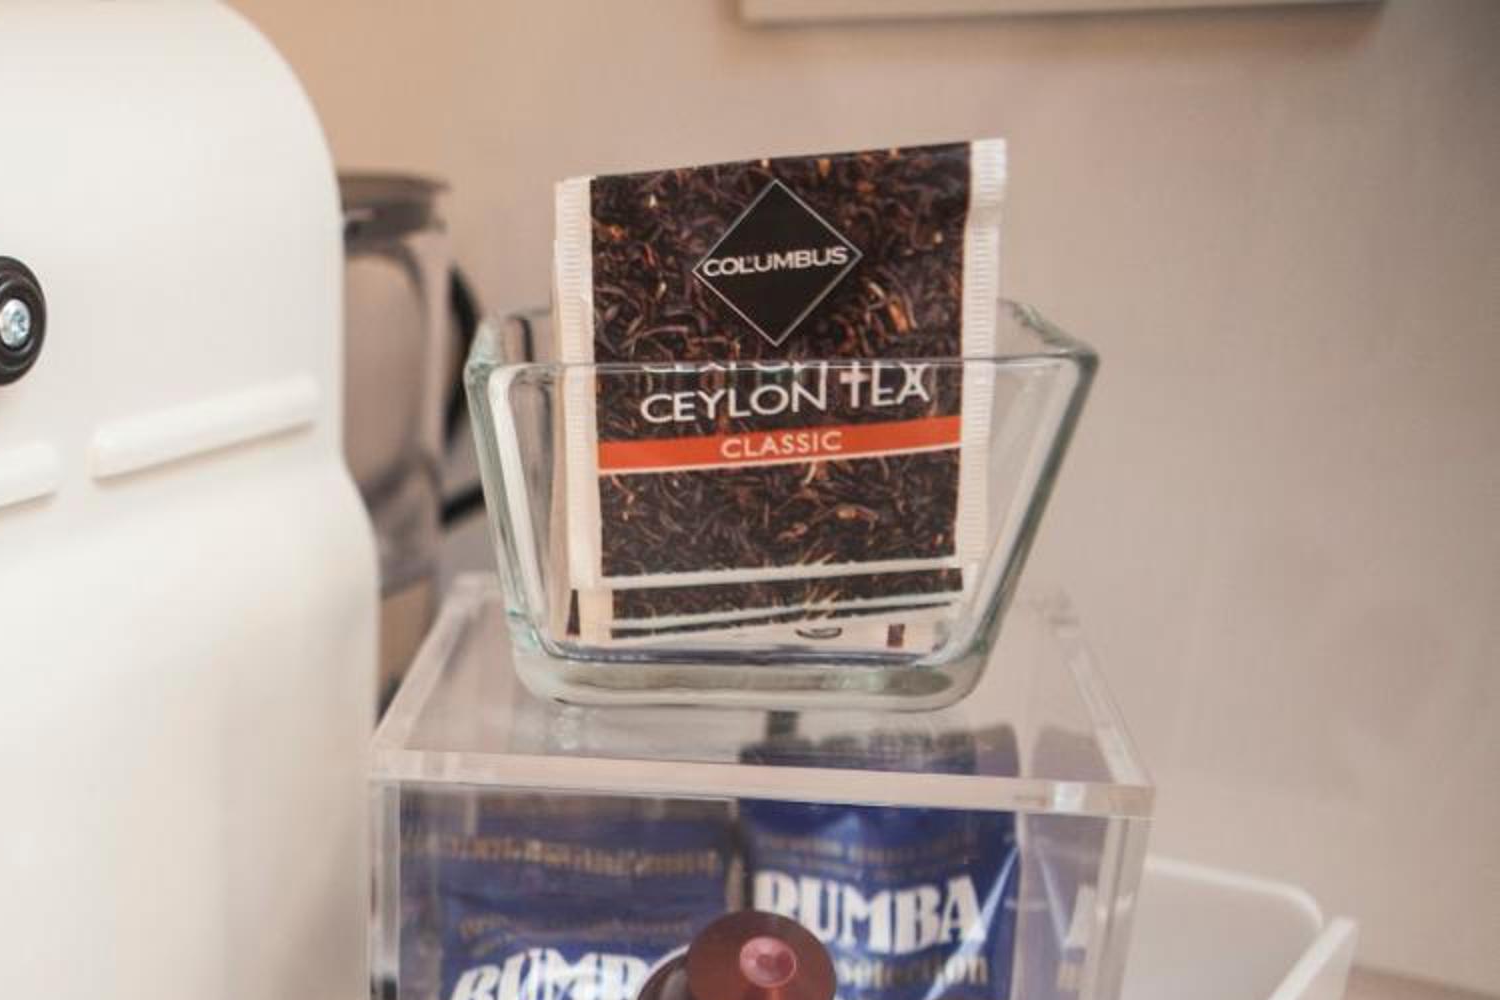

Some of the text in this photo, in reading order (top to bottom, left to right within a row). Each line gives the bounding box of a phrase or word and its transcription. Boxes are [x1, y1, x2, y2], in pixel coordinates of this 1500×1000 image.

[702, 246, 848, 277] COLUMBUS
[640, 378, 827, 423] CEYLON
[720, 431, 843, 459] CLASSIC
